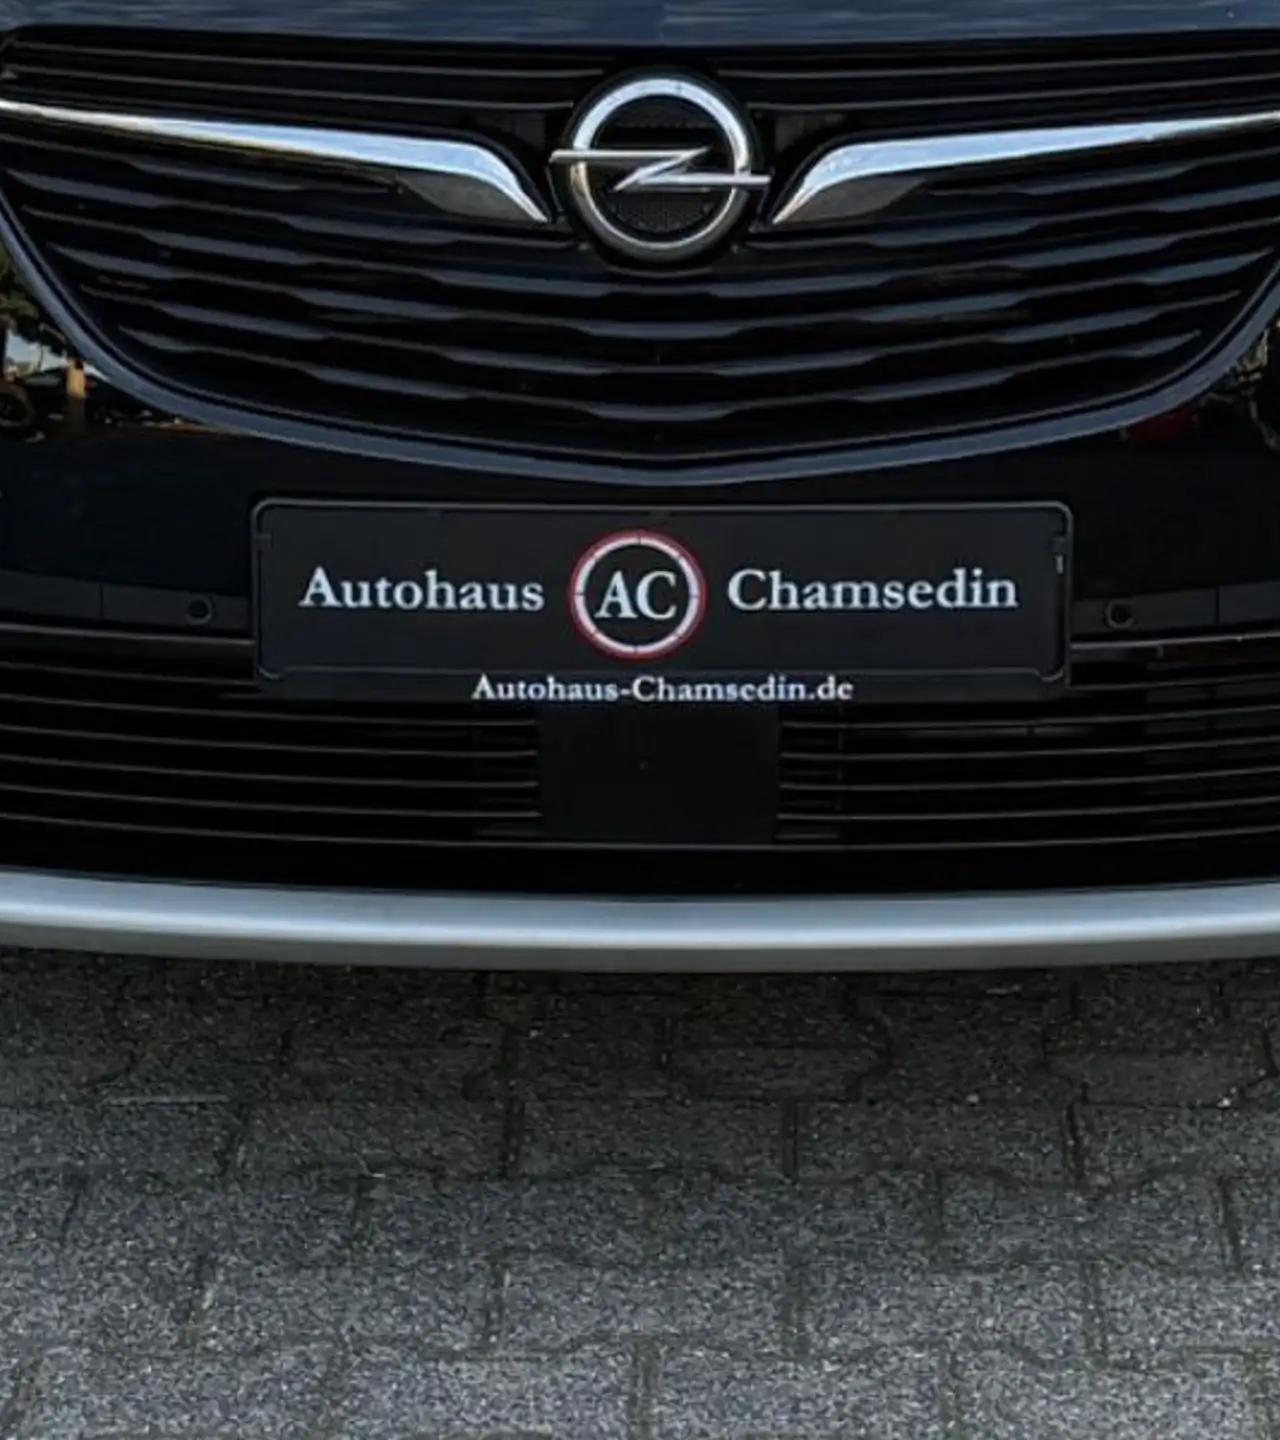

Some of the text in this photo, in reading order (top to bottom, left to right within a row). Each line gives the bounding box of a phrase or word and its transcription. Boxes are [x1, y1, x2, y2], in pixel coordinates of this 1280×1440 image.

[299, 566, 1019, 620] Autohaus AC Chamsedin
[471, 673, 855, 703] Autohaus-Chamsedin.de
